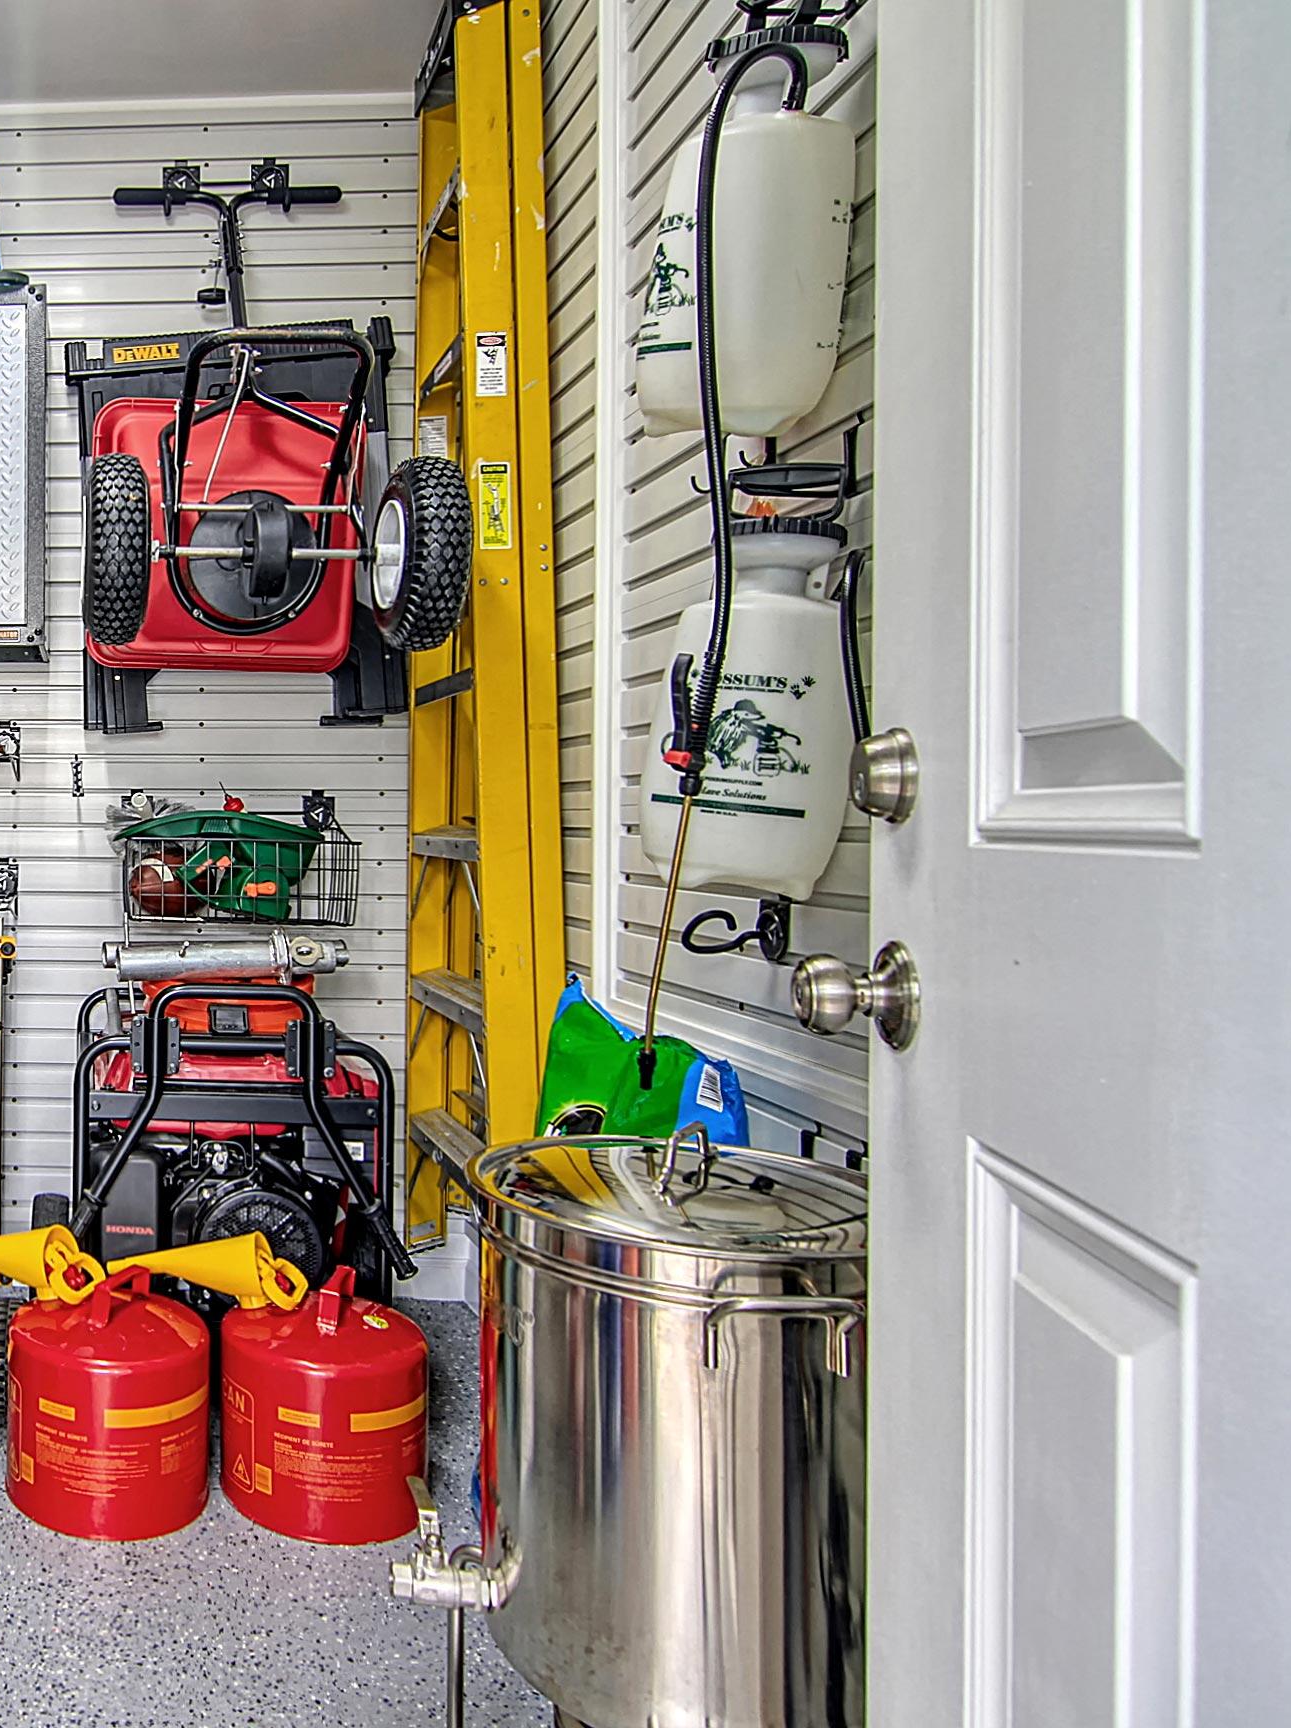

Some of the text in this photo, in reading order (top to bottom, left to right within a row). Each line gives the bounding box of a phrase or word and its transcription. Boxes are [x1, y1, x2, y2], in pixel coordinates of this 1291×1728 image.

[722, 672, 788, 689] SSUM'S
[721, 787, 767, 801] Solutions
[105, 1224, 156, 1237] HONDA
